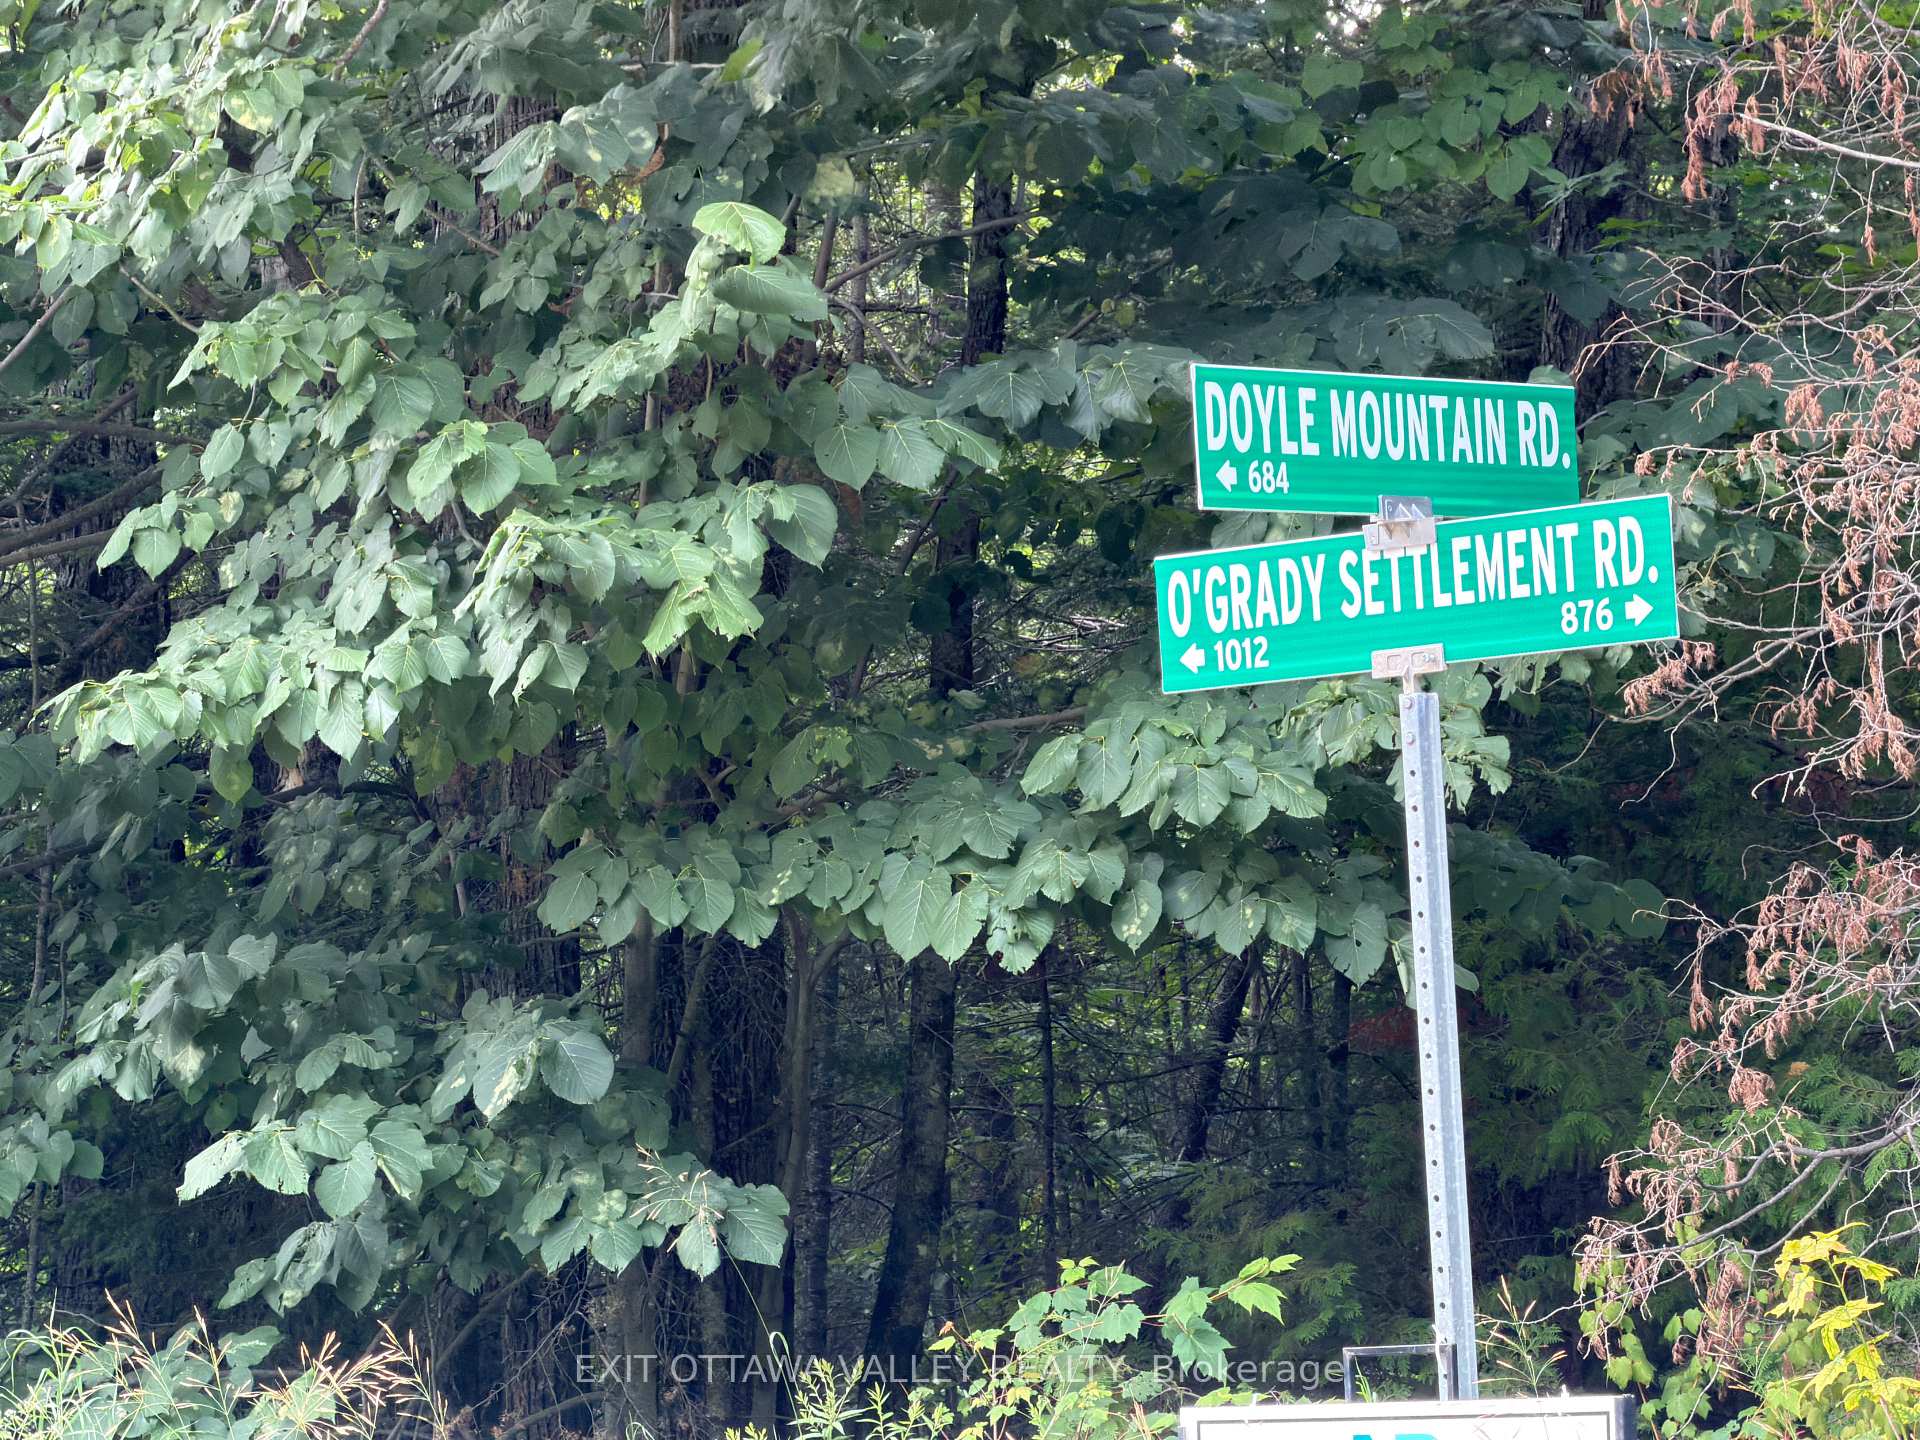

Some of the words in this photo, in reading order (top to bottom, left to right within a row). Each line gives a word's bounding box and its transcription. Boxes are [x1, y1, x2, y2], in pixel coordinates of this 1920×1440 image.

[1204, 381, 1320, 456] DOYLE
[1329, 389, 1507, 464] MOUNTAIN
[1517, 400, 1571, 469] RD.
[1248, 459, 1290, 494] 684
[1167, 553, 1326, 638] O'GRADY
[1339, 522, 1579, 619] SETTLEMENT
[1592, 515, 1659, 590] RD.
[1560, 597, 1614, 635] 876
[1213, 635, 1270, 672] 1012
